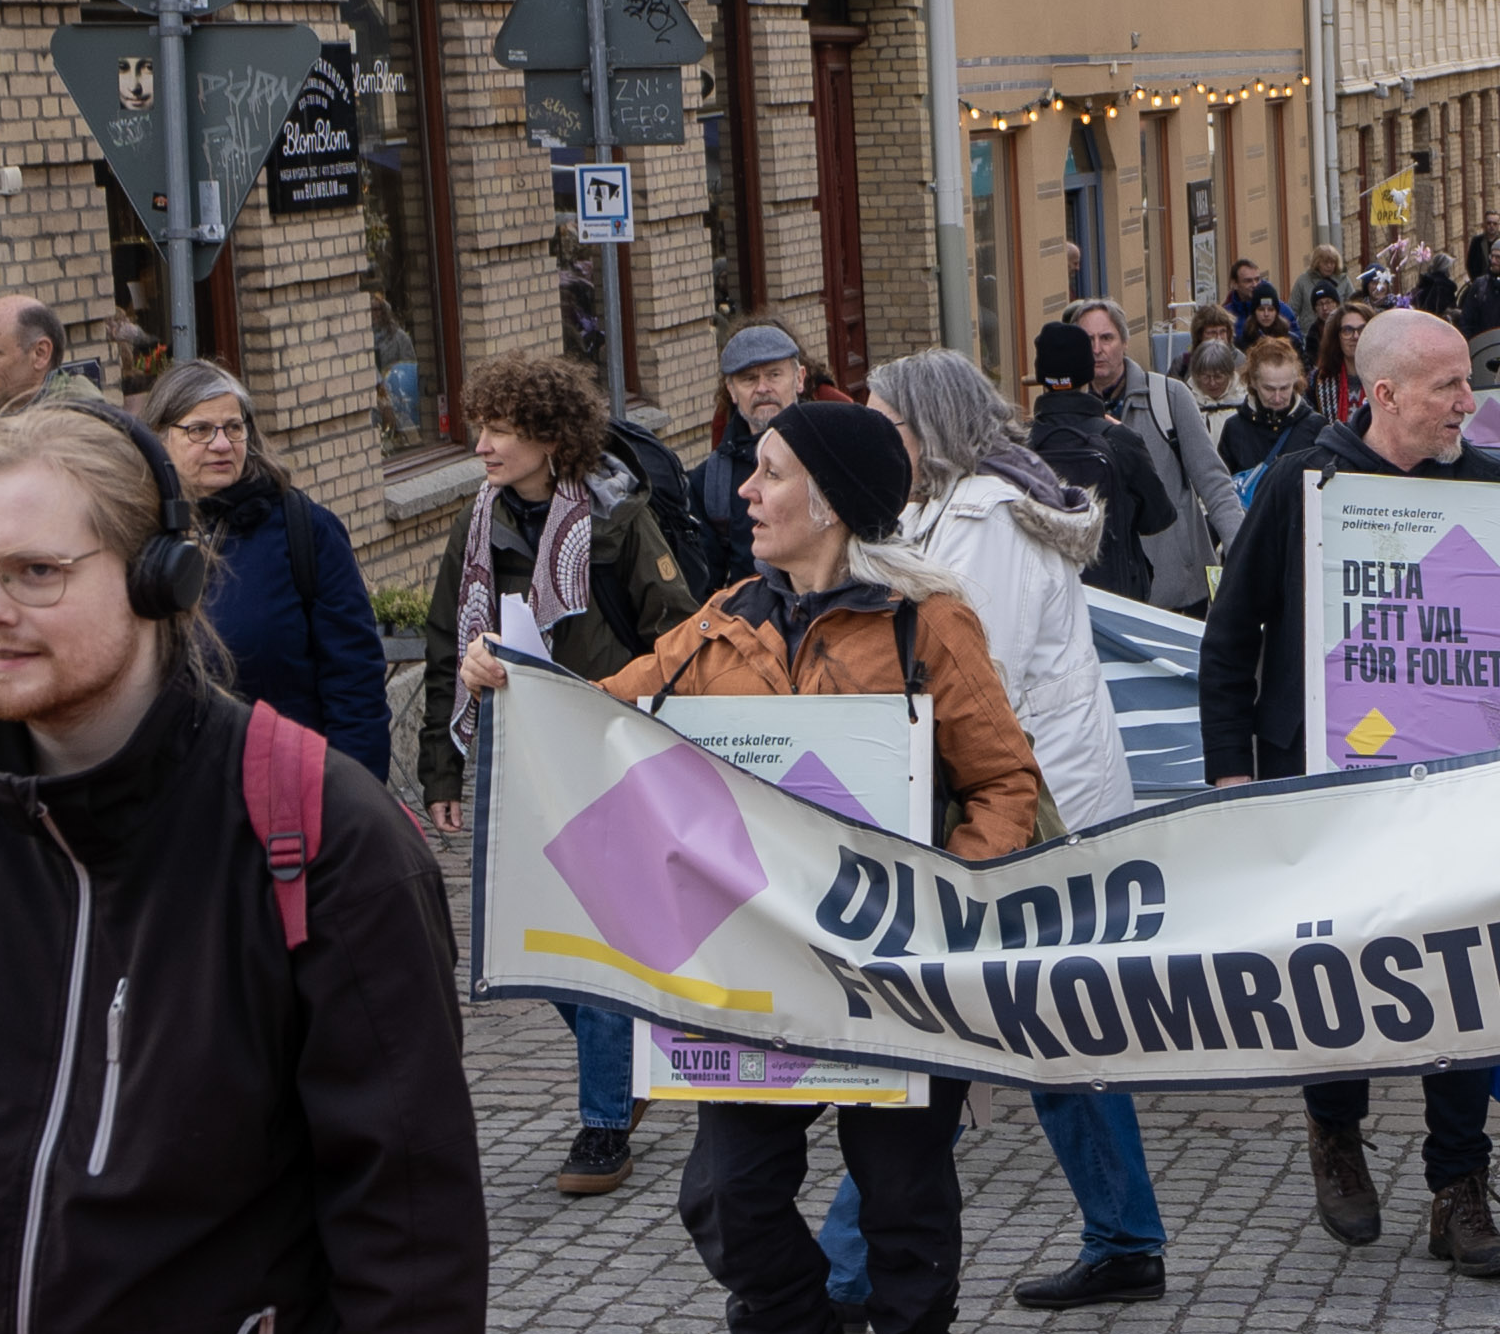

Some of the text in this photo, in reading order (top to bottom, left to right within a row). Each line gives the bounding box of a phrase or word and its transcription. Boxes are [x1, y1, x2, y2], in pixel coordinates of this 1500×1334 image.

[282, 118, 350, 157] BlomBlom
[1342, 504, 1446, 522] Klimatet eskalerar,
[1342, 519, 1437, 534] politiken fallerar.
[1342, 559, 1424, 600] DELTA
[1343, 602, 1469, 644] I ETT VAL
[1343, 643, 1397, 684] FÖR
[682, 733, 794, 748] imatet eskalerar,
[733, 751, 783, 766] fallerar.
[671, 1049, 731, 1070] OLYDIG
[671, 1072, 731, 1082] FOLKOMRÖSTNING
